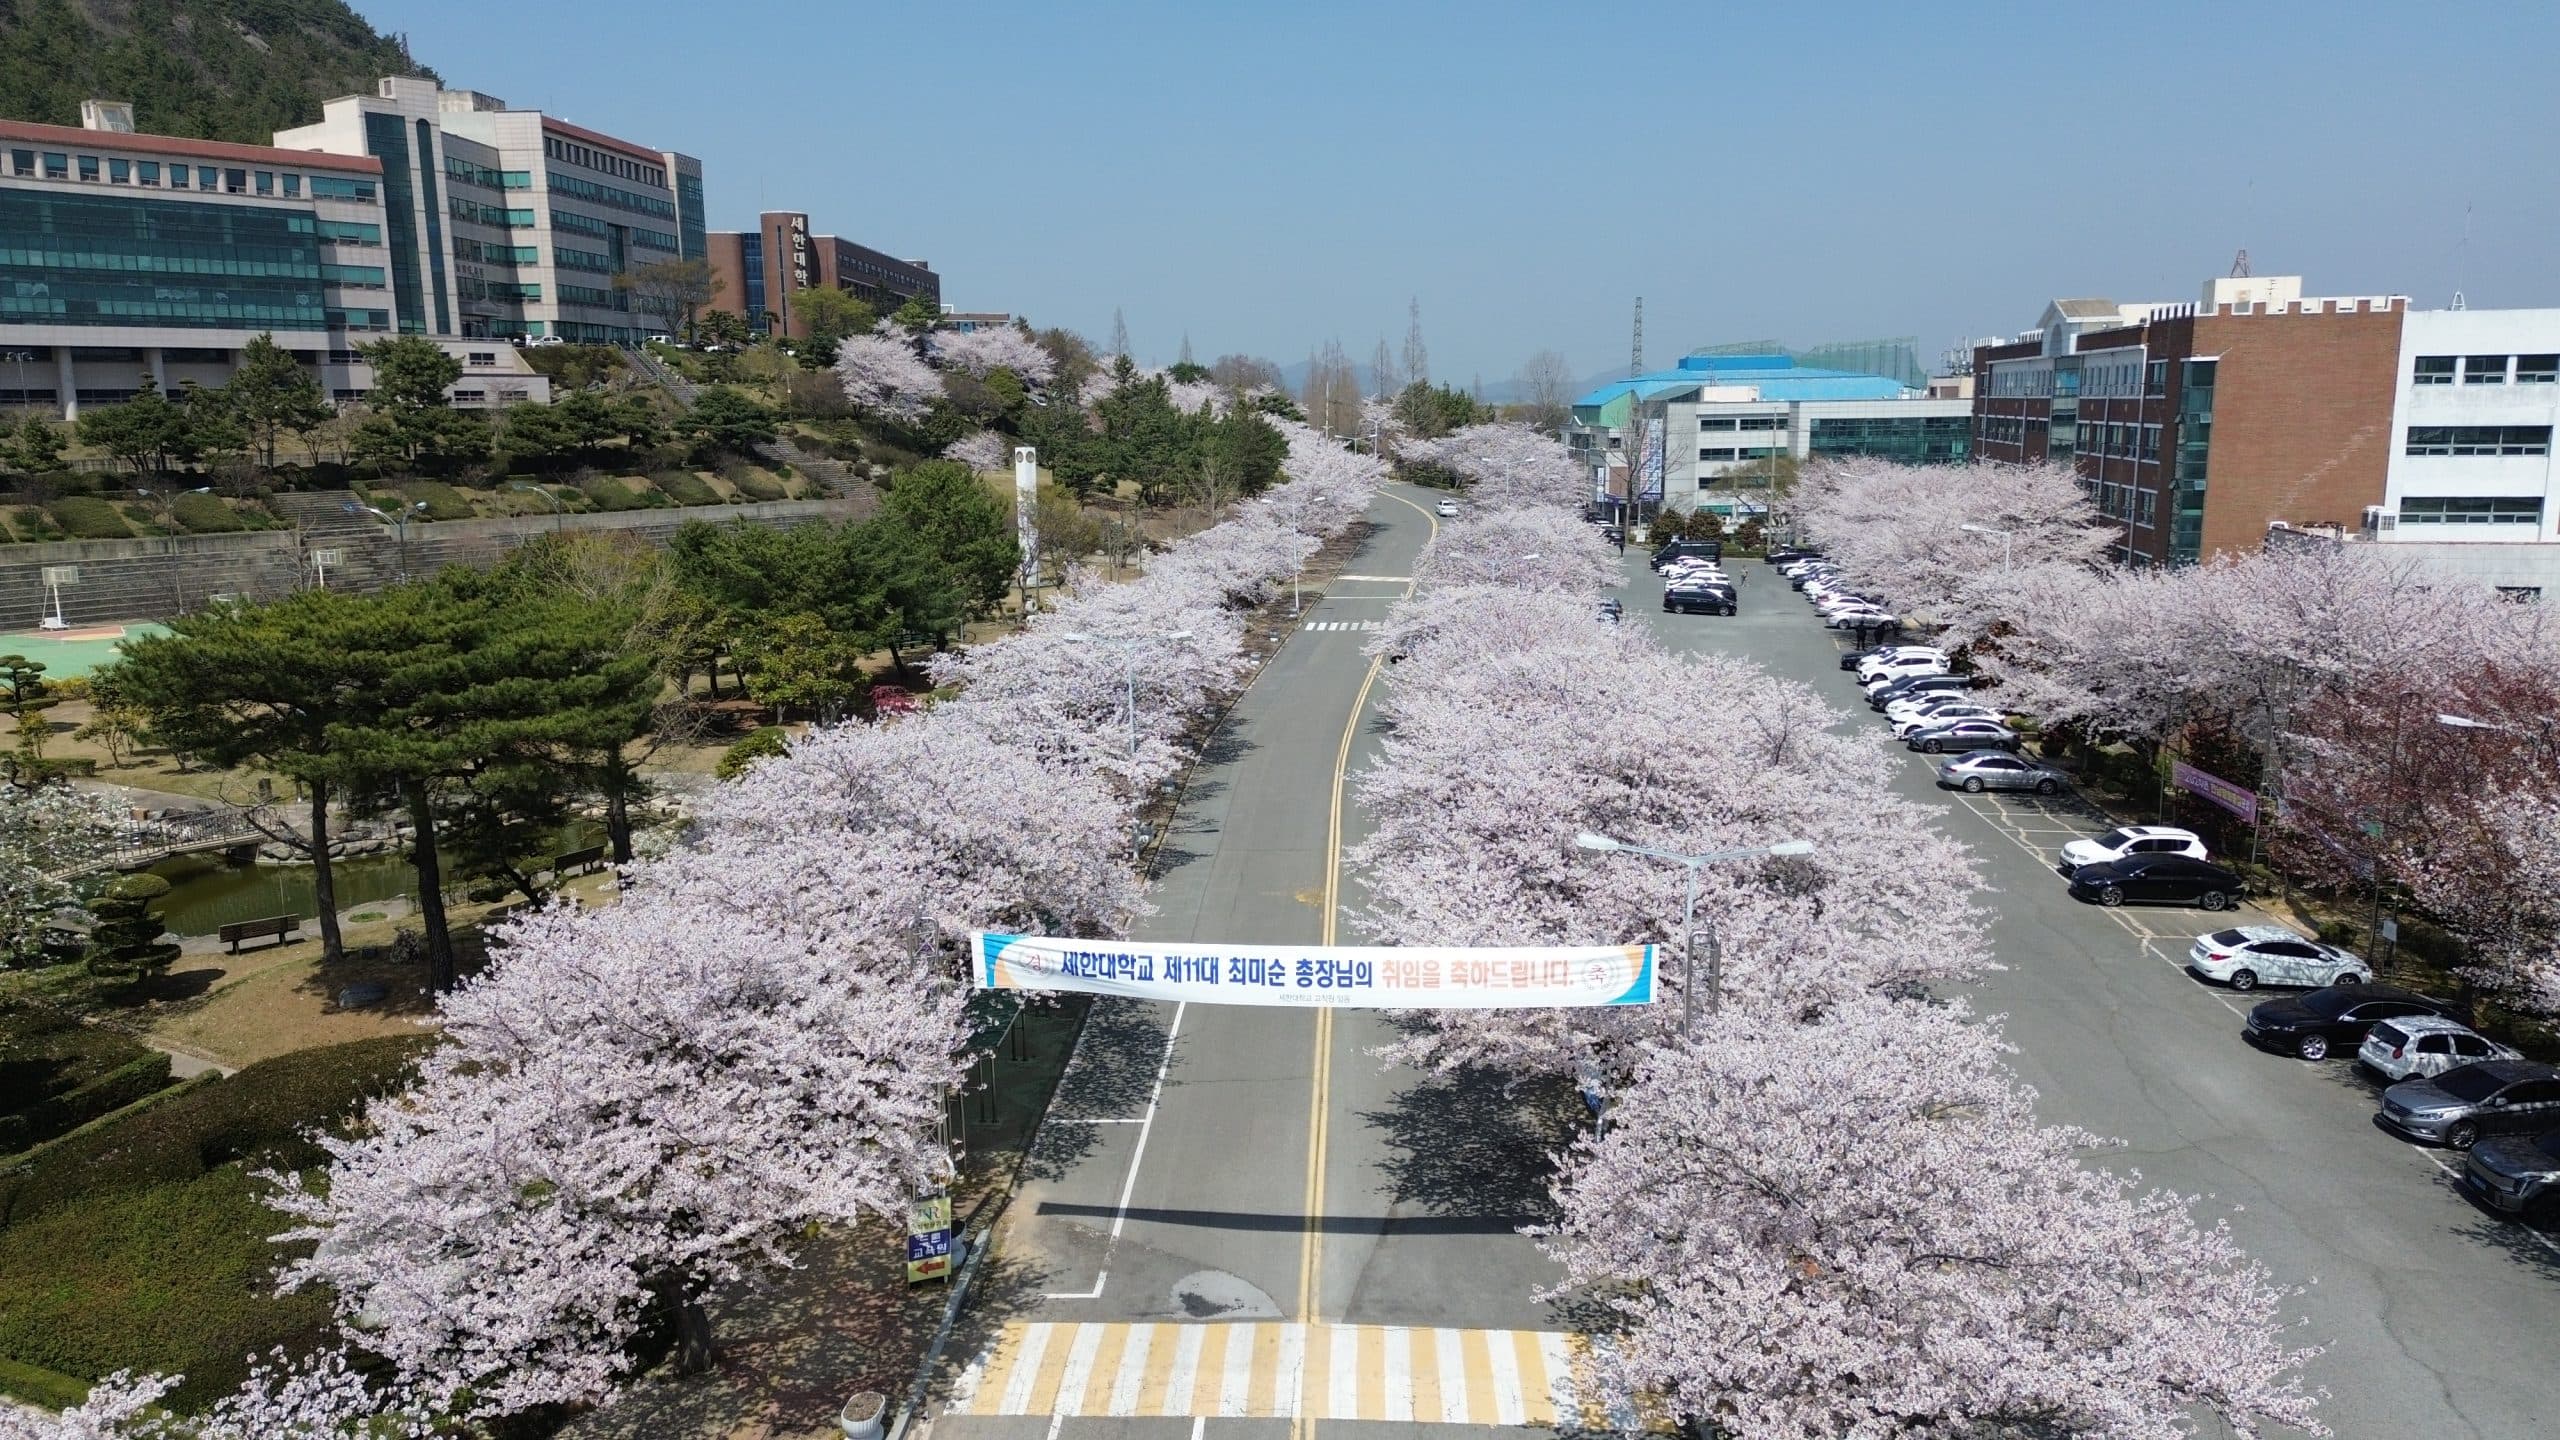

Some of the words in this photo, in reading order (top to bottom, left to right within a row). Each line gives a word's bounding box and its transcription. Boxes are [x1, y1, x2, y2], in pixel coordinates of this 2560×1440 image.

[1061, 951, 1154, 982] 세한대학교
[1163, 955, 1220, 985] 제11대
[1228, 957, 1286, 987] 최미순
[1295, 959, 1373, 988] 총장님의
[1382, 960, 1441, 989] 취임을
